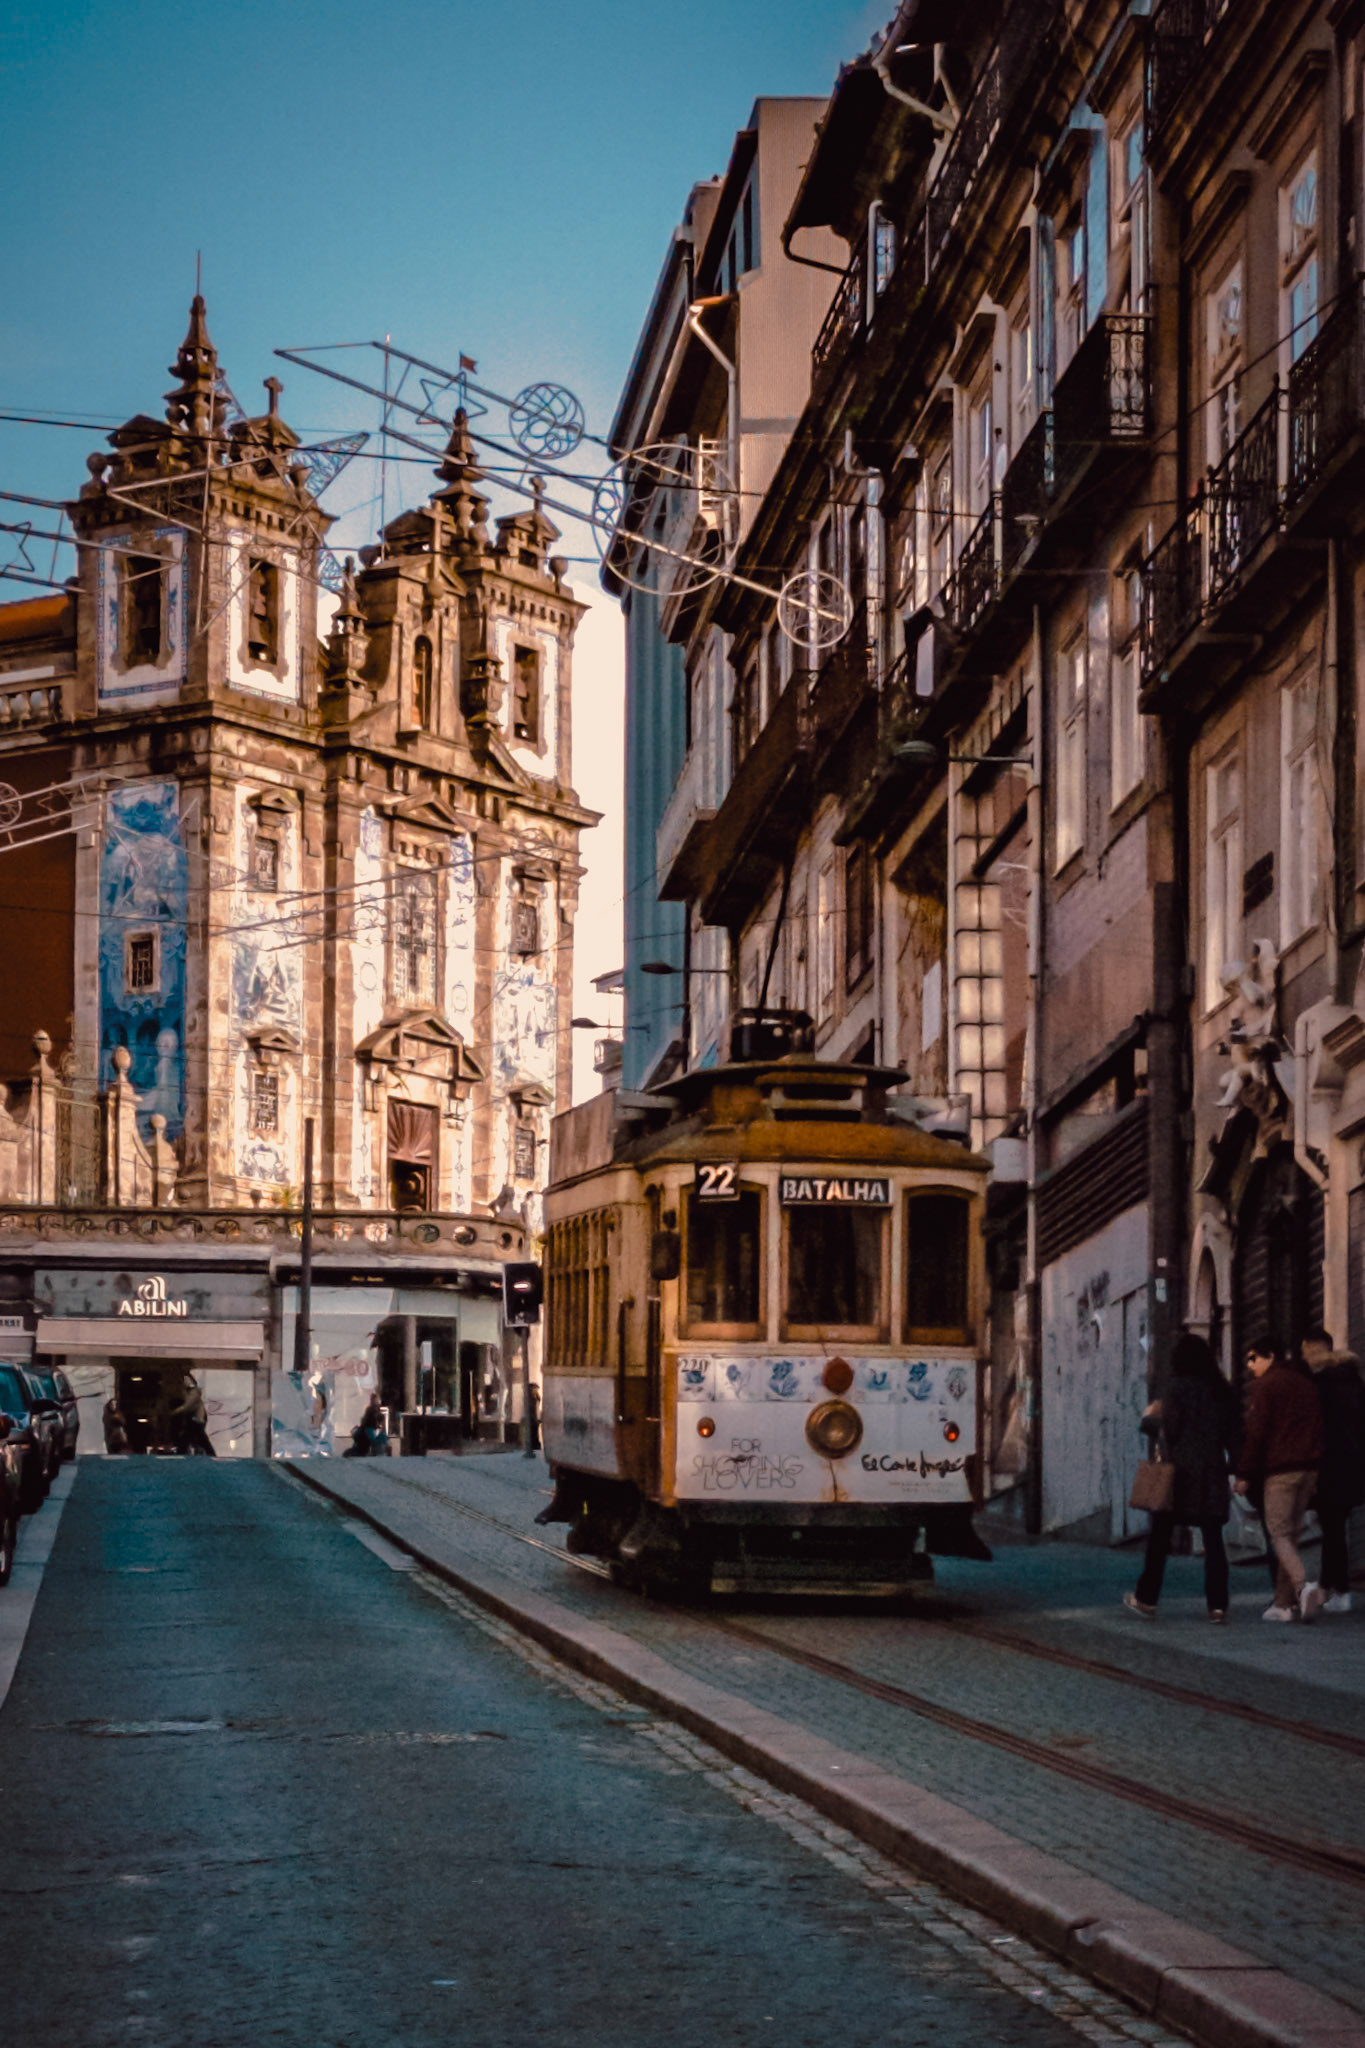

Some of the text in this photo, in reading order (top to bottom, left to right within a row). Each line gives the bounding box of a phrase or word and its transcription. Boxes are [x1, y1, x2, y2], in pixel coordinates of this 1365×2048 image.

[699, 1165, 735, 1196] 22
[782, 1178, 886, 1202] BATALHA
[118, 1299, 188, 1316] ABILINI
[731, 1438, 761, 1453] FOR
[703, 1467, 798, 1491] LOVERS
